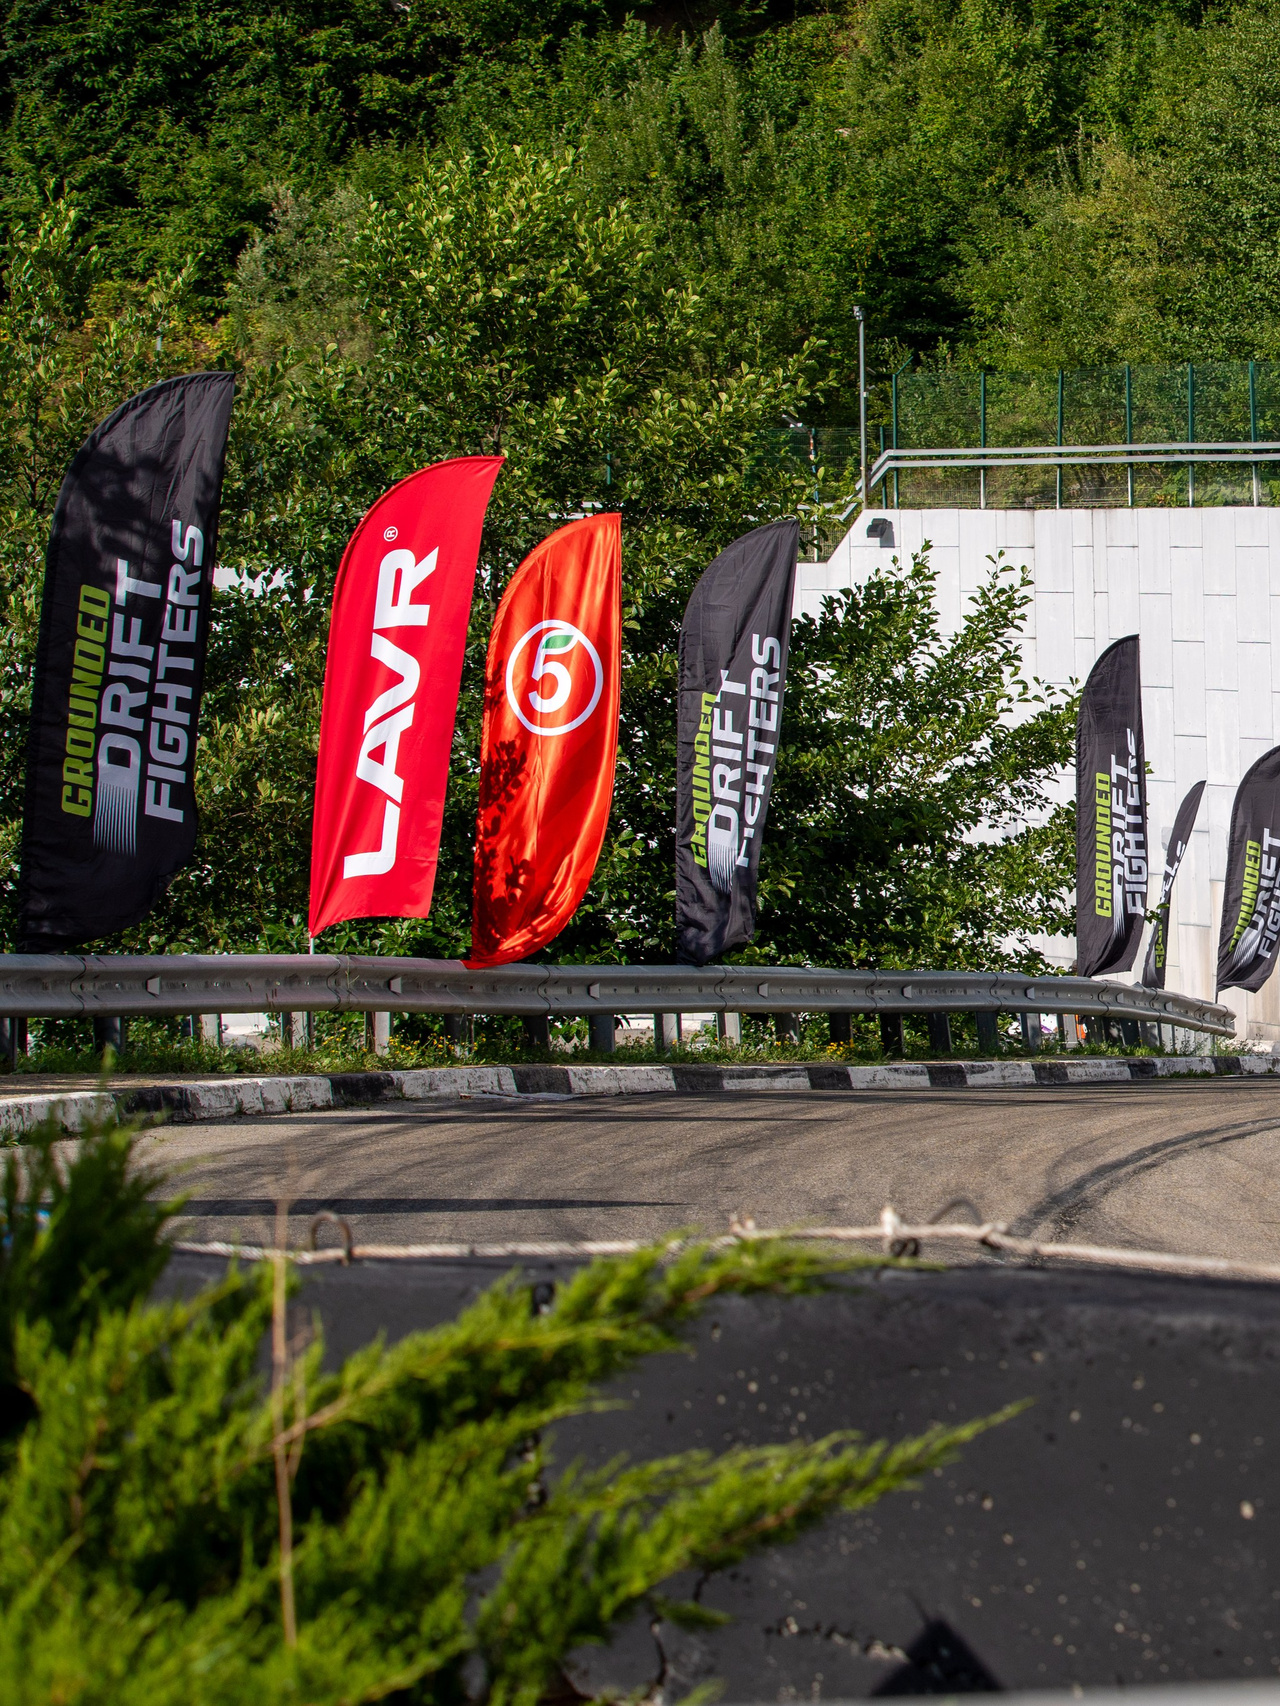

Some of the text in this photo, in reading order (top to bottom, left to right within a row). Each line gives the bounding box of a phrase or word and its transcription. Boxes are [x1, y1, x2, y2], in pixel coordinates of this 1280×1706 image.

[61, 584, 111, 818] GROUNDED
[96, 558, 162, 790] DRIFT
[144, 519, 204, 823] FIGHTERS
[343, 546, 439, 879] LAVR
[528, 632, 576, 713] 5
[707, 669, 747, 856] DRIFT
[1095, 772, 1112, 918] GROUNDED
[1111, 754, 1128, 912] DRIFT
[1124, 728, 1148, 917] FIGHTERS
